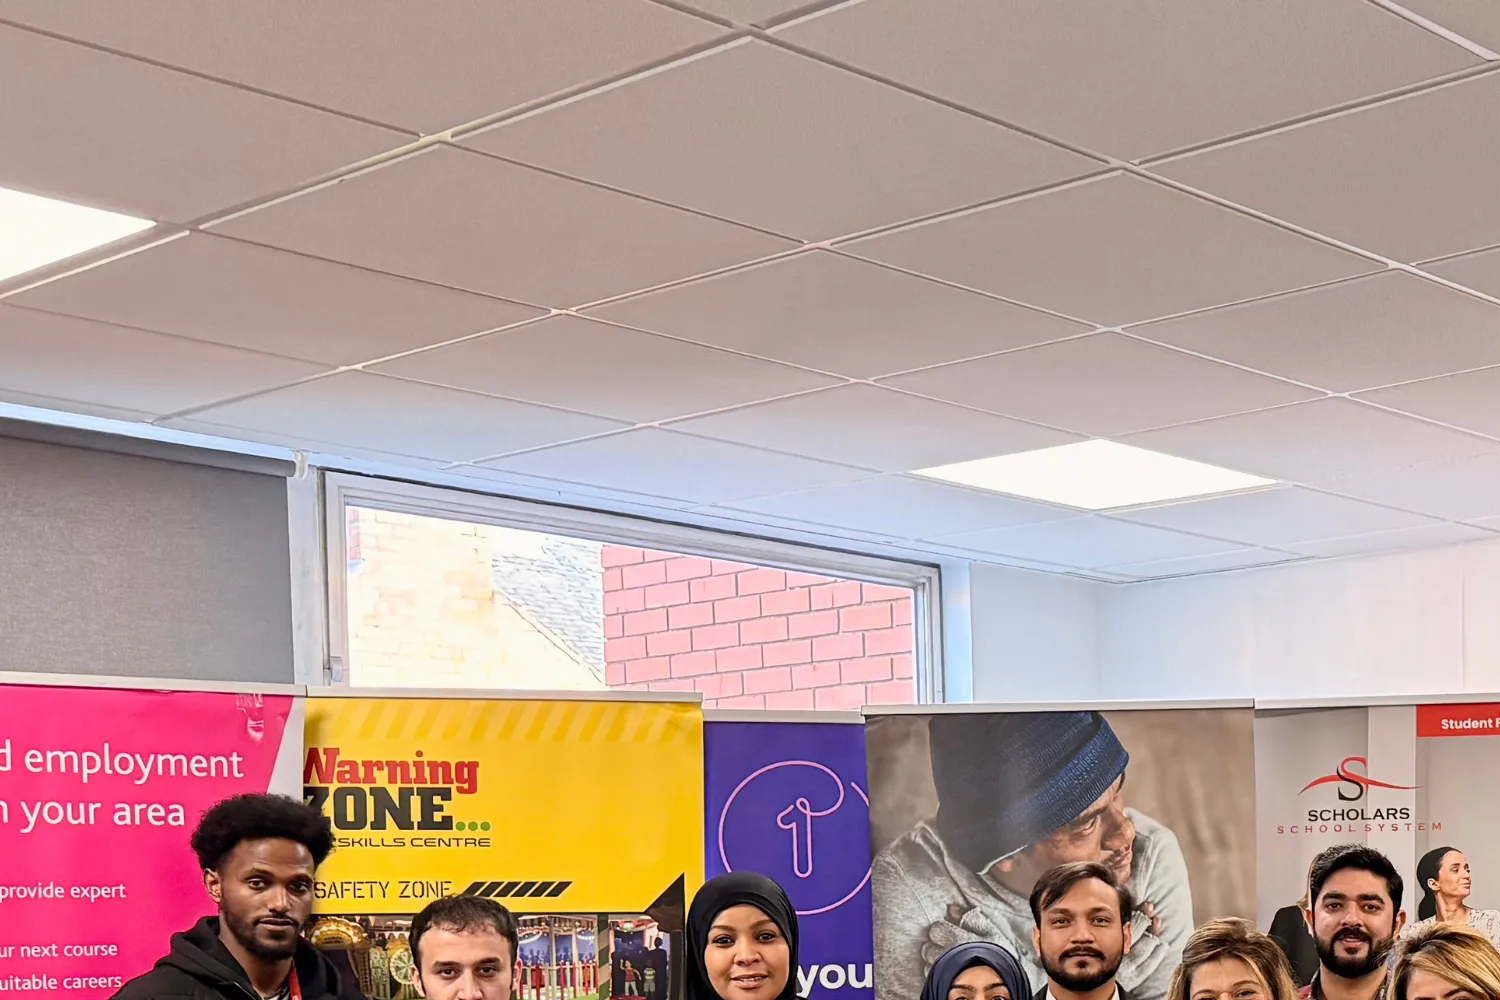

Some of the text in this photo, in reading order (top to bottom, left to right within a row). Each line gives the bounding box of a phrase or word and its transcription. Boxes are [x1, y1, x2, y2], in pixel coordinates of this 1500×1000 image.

[1441, 717, 1492, 730] Student
[24, 742, 244, 785] employment
[20, 801, 101, 833] your
[113, 803, 185, 826] area
[1307, 807, 1410, 822] SCHOLARS
[1277, 822, 1442, 834] SCHOOL SYSTEM
[338, 837, 491, 848] SKILLS CENTRE
[0, 881, 126, 902] provide expert
[314, 881, 452, 899] SAFETY ZONE
[20, 944, 58, 957] next
[63, 944, 118, 956] course
[63, 976, 122, 988] careers
